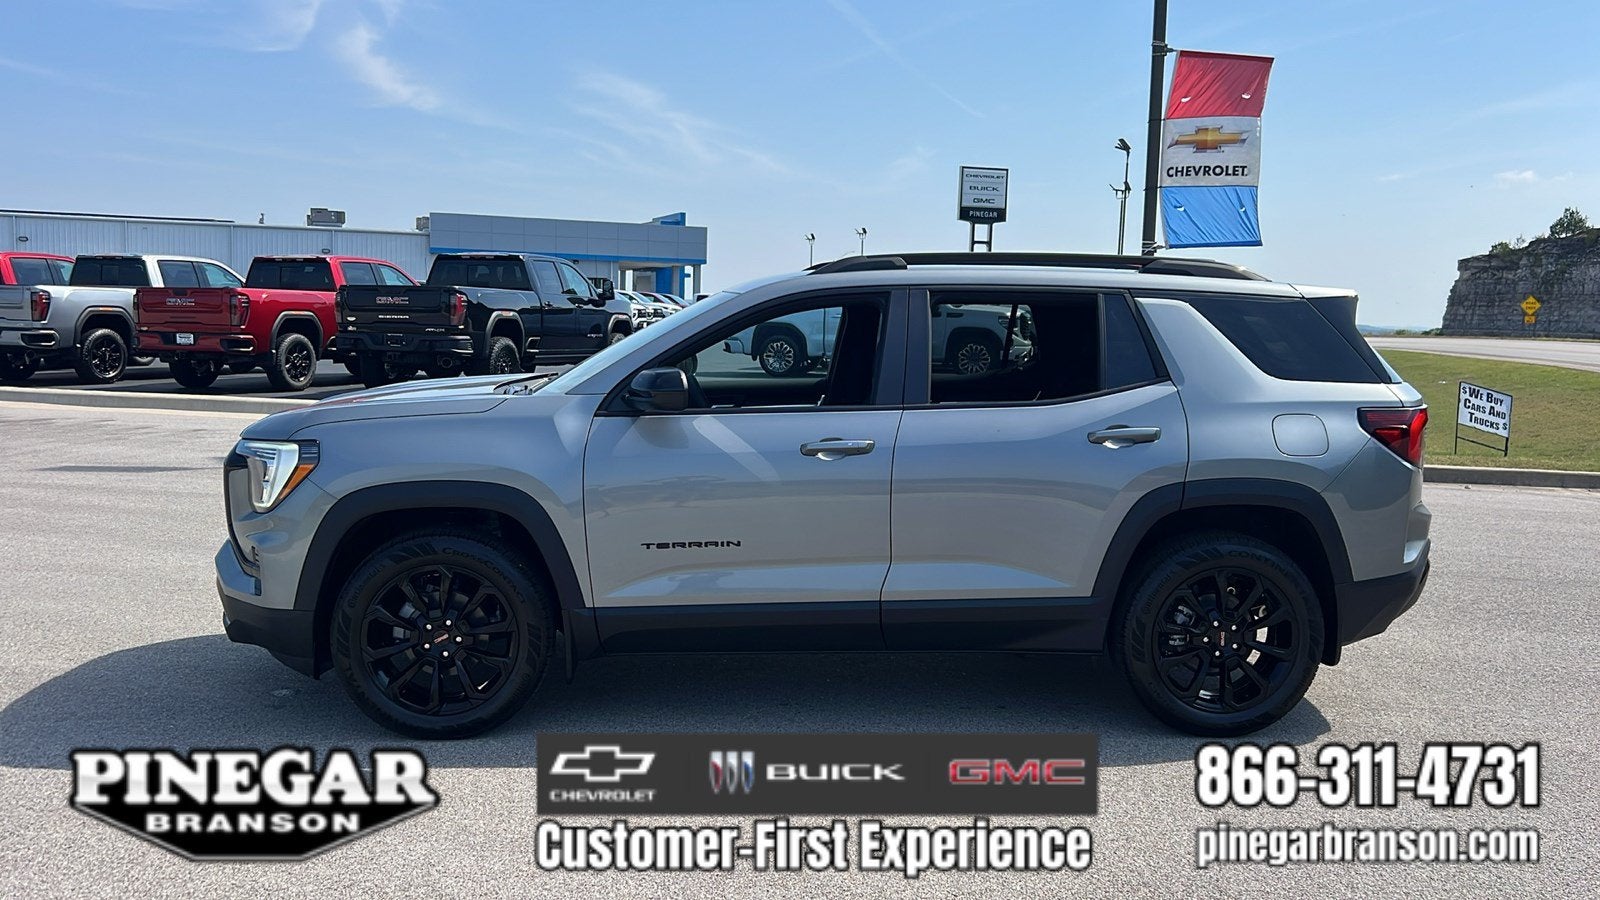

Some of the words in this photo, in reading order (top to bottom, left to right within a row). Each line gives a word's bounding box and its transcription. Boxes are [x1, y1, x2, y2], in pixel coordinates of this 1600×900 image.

[1166, 165, 1247, 178] CHEVROLET
[969, 210, 998, 218] PINEGAR
[1486, 392, 1504, 406] BUY
[1463, 398, 1487, 414] CARS
[1488, 405, 1507, 420] AND
[1468, 411, 1500, 430] TRUCKS
[641, 540, 742, 550] TERRAIN
